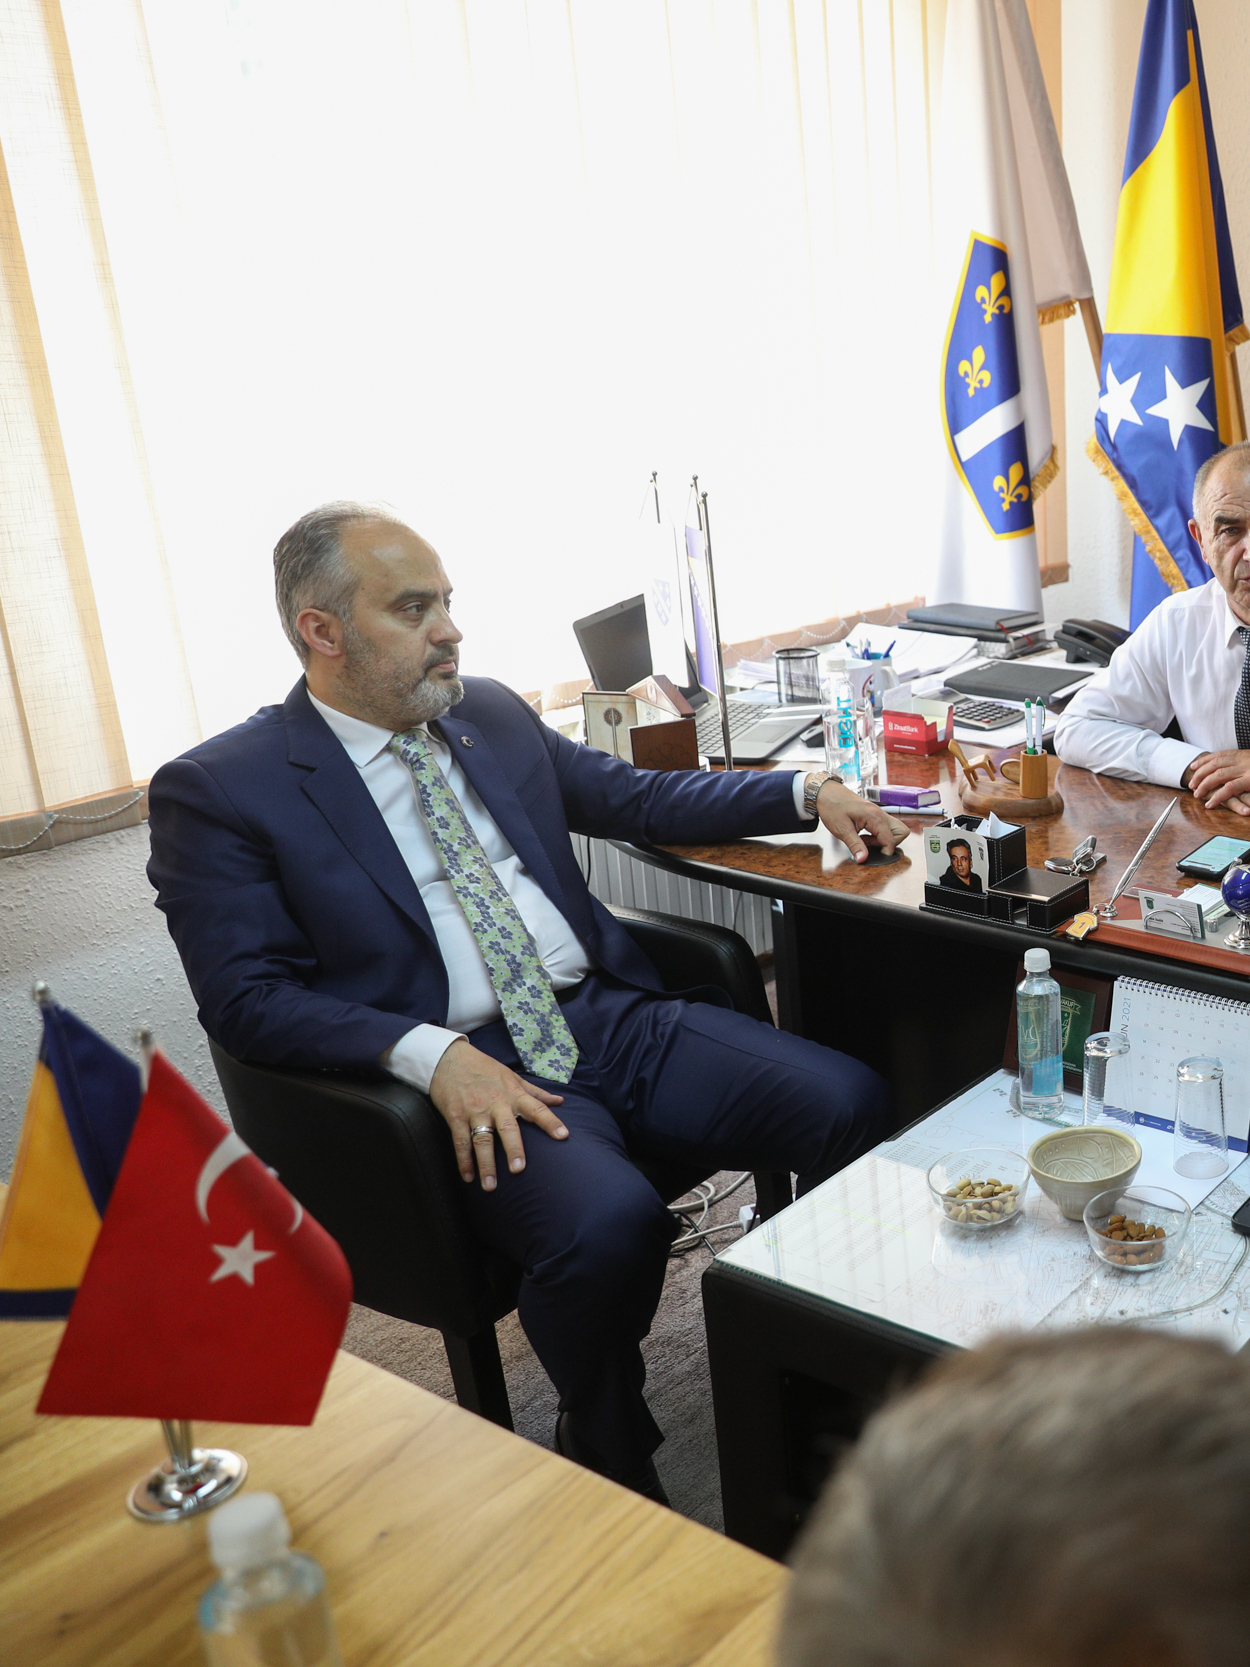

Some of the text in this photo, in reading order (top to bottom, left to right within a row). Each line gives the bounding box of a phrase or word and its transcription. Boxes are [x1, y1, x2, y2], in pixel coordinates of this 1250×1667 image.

[837, 697, 853, 748] EIGHT
[1120, 997, 1132, 1038] UN 2021
